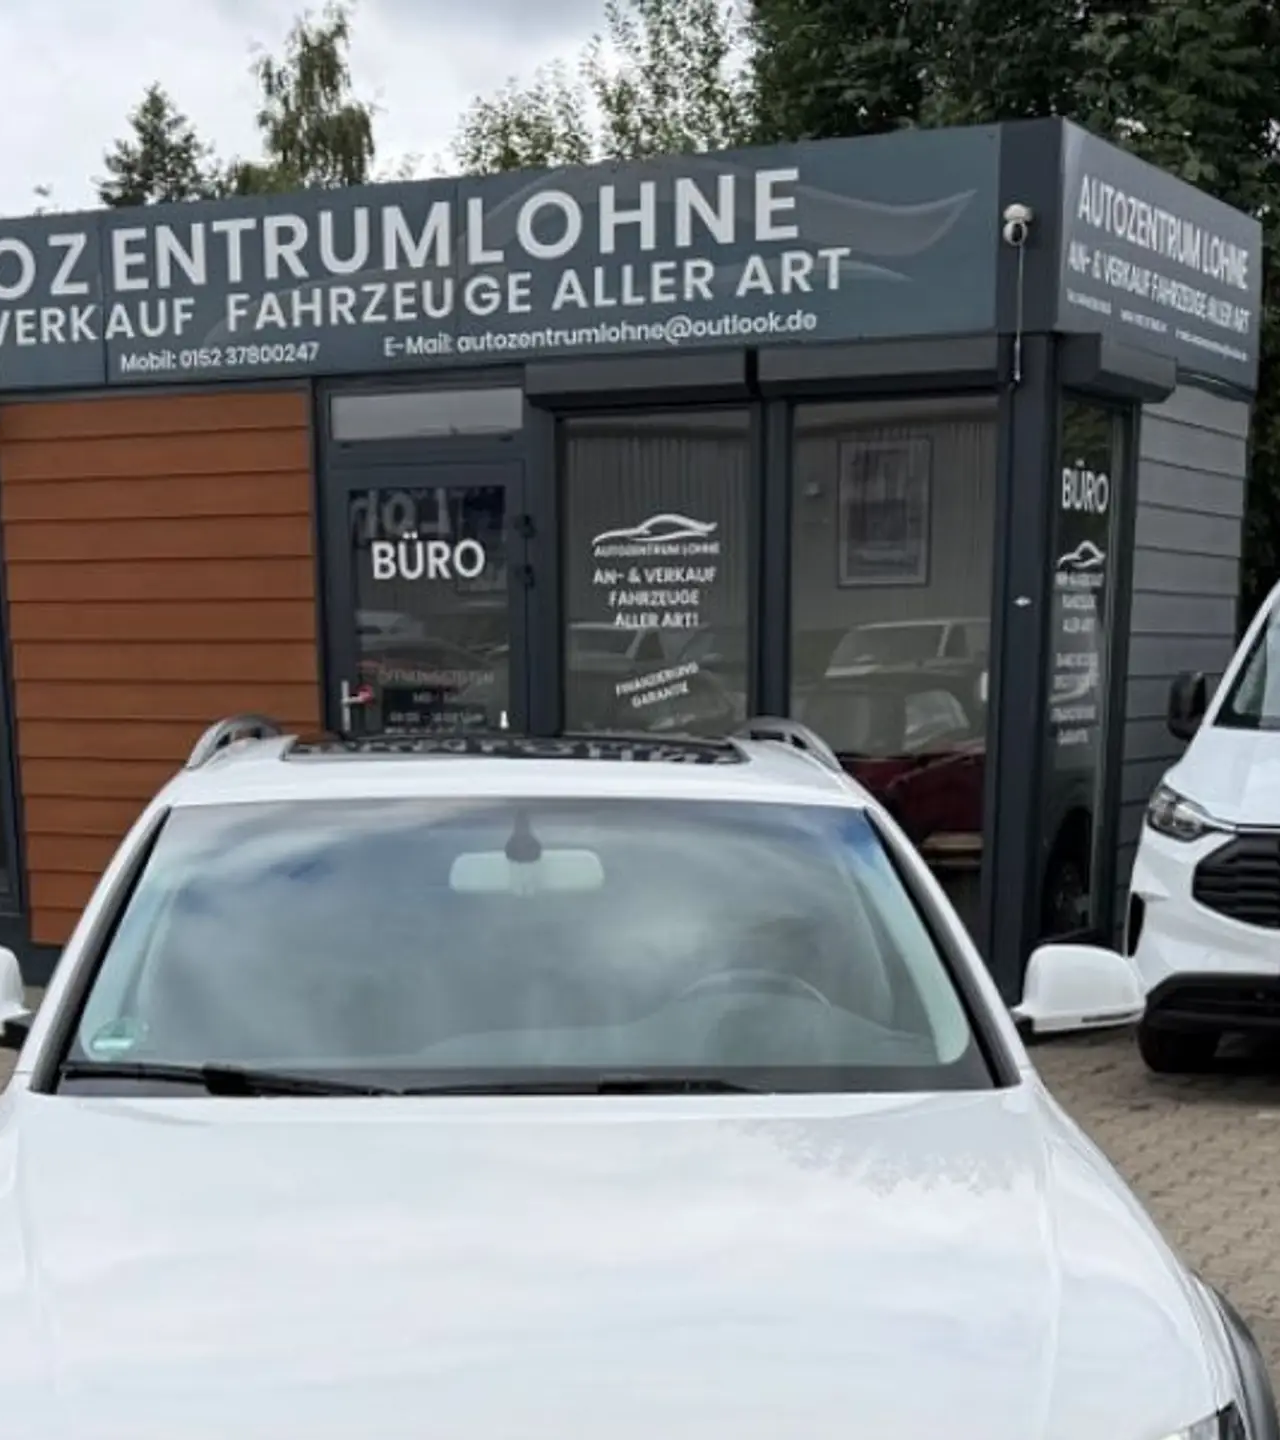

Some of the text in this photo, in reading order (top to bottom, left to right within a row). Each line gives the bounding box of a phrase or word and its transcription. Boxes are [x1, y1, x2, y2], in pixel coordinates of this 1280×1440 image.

[225, 270, 532, 334] FAHRZEUGE
[550, 256, 715, 312] ALLER
[734, 245, 852, 297] ART
[120, 340, 320, 372] Mobil: 0152 37800247
[1062, 458, 1109, 515] BÜRO
[371, 529, 486, 580] BÜRO
[643, 565, 717, 584] VERKAUF
